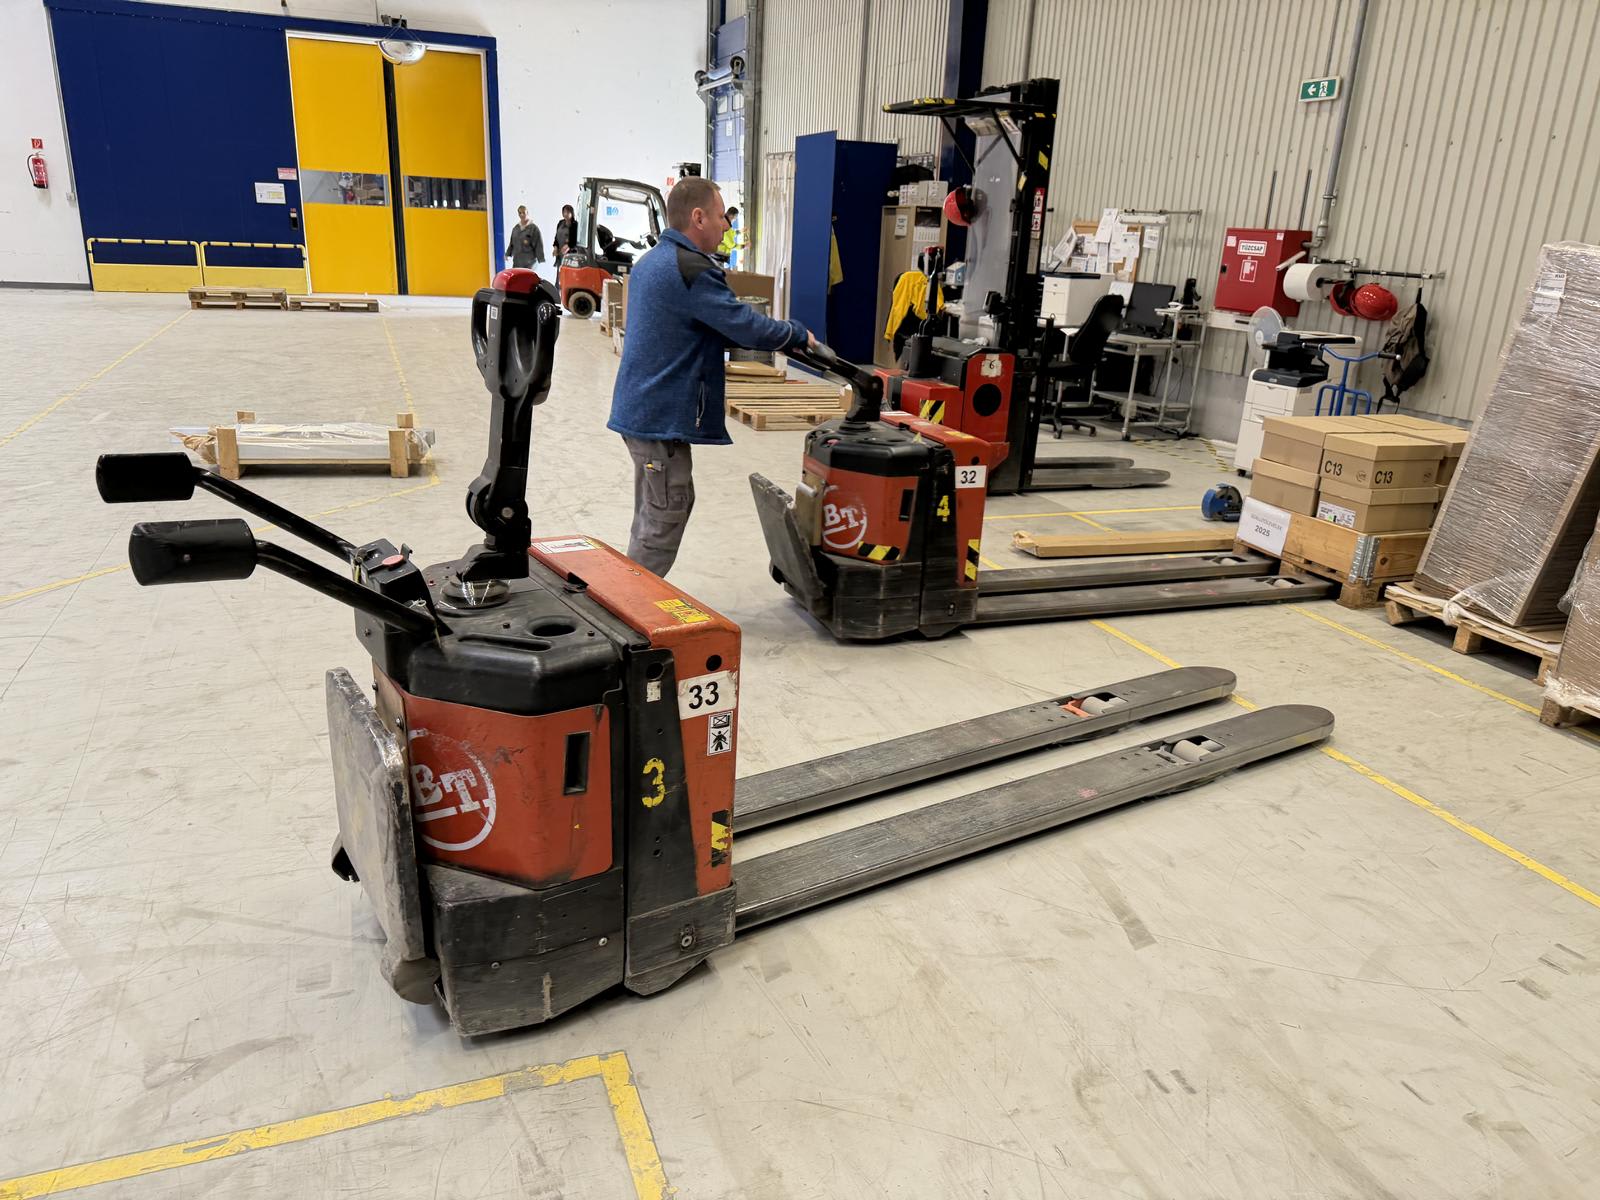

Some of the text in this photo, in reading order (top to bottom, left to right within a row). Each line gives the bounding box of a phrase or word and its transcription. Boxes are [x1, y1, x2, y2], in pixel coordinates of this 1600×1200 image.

[960, 470, 977, 484] 32
[1324, 460, 1343, 477] C13
[1374, 470, 1393, 484] C13
[823, 503, 860, 529] BT
[936, 495, 950, 522] 4
[1254, 525, 1270, 537] 2025
[688, 681, 719, 709] 33
[410, 763, 481, 813] BT
[642, 757, 665, 808] 3
